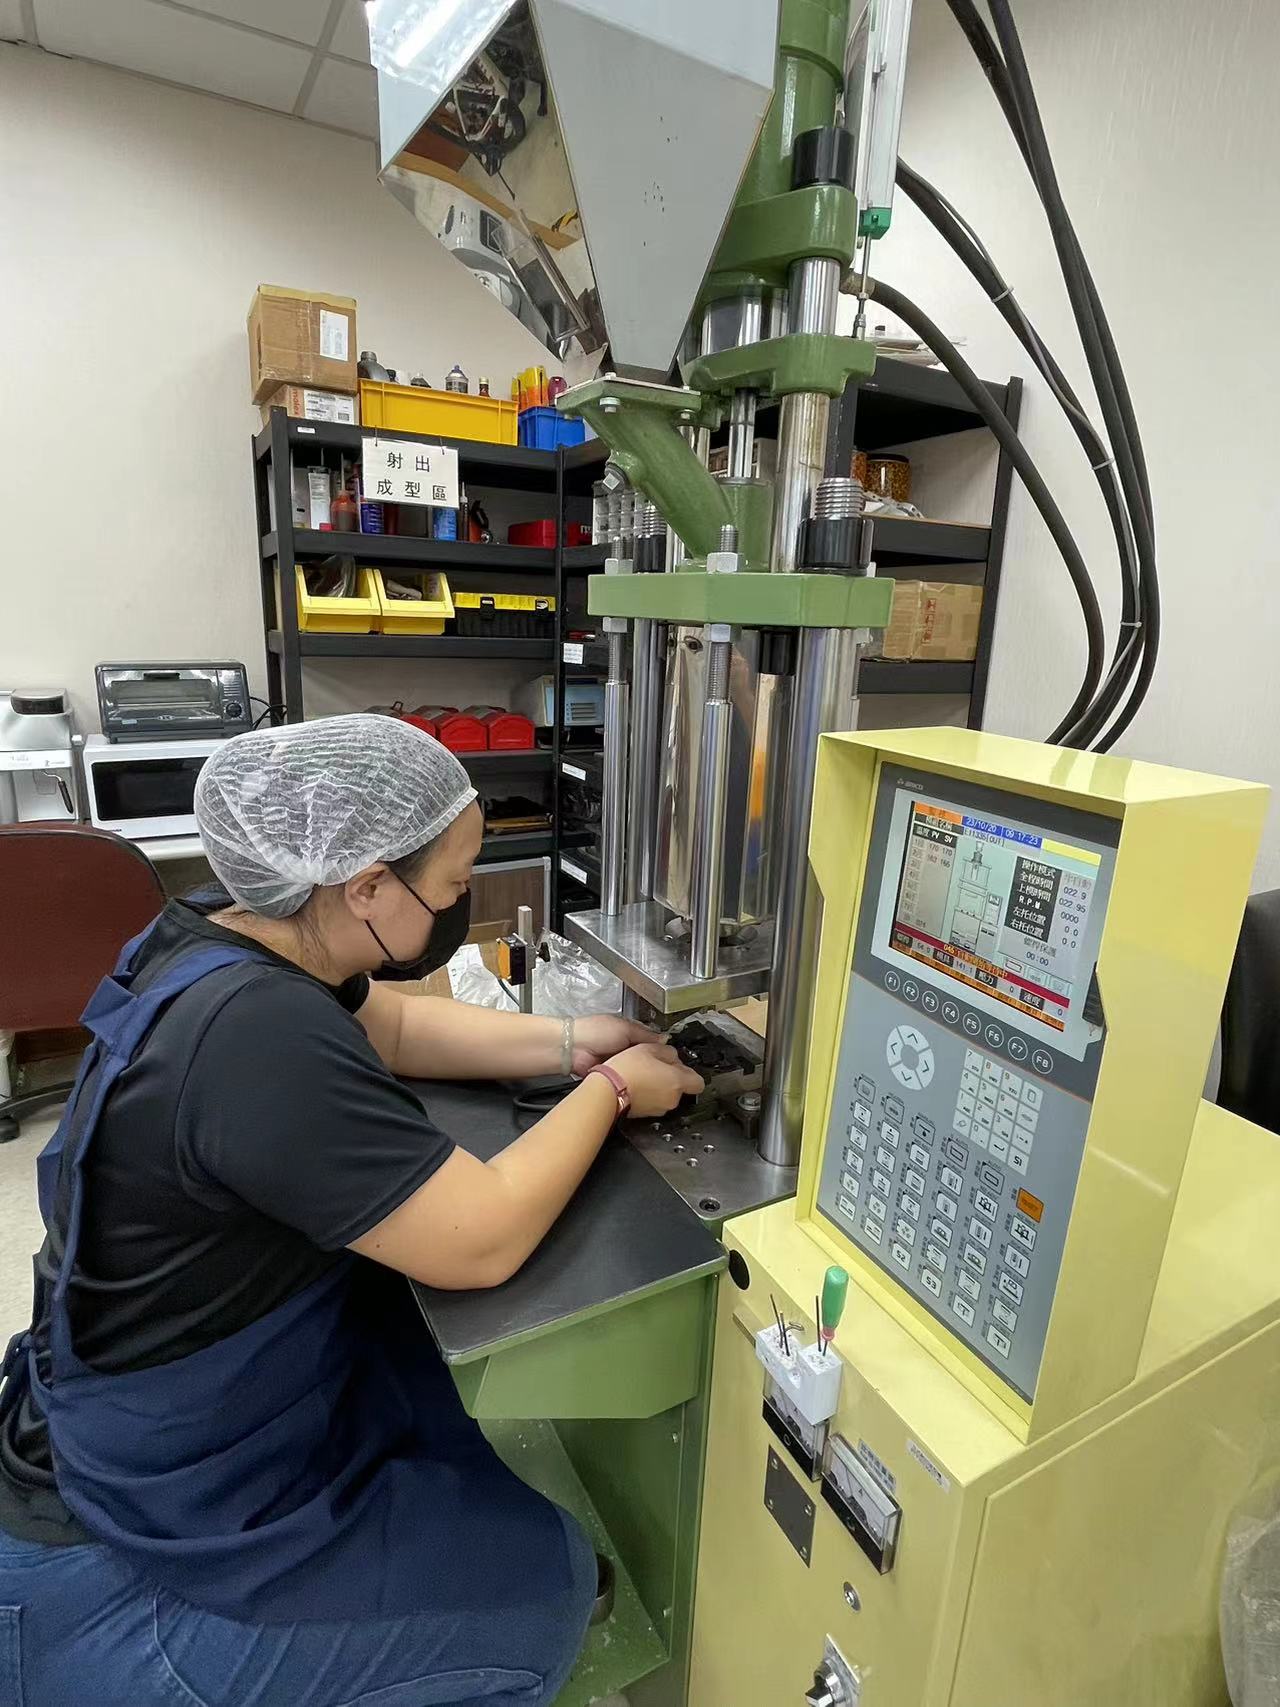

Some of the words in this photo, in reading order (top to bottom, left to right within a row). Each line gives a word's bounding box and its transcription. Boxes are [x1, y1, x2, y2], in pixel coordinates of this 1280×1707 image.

[387, 451, 430, 473] 射出
[376, 479, 447, 501] 成型區
[967, 818, 996, 833] 23/10/20
[944, 835, 952, 843] SV
[1060, 911, 1079, 924] 0000
[1026, 951, 1049, 966] 00:00
[888, 977, 896, 986] F1
[906, 986, 915, 996] F2
[925, 996, 935, 1006] F3
[945, 1006, 955, 1017] F4
[966, 1018, 977, 1029] F5
[988, 1029, 999, 1041] F6
[1012, 1042, 1023, 1054] F7
[1036, 1055, 1049, 1068] F8
[896, 1250, 906, 1262] S2
[926, 1276, 937, 1290] S3
